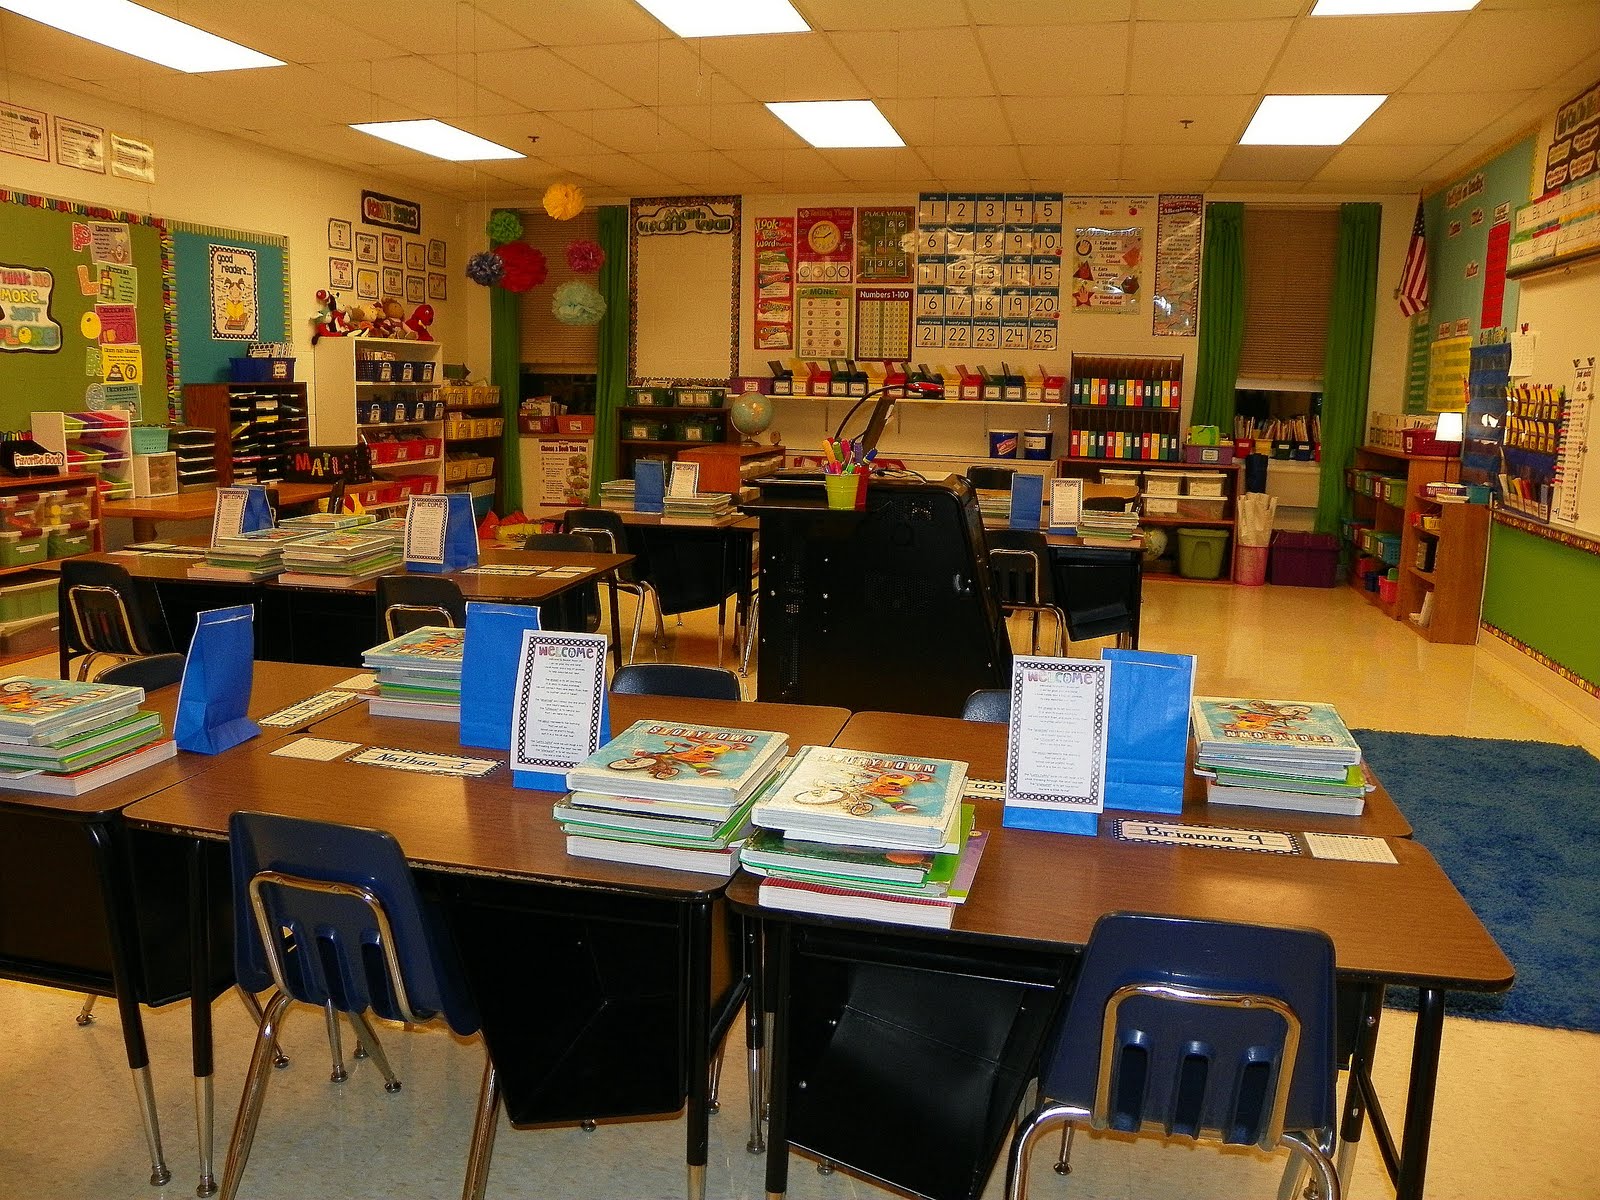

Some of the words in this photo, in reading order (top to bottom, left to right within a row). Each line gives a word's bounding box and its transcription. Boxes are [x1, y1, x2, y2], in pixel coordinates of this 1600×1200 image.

[957, 203, 966, 217] 2
[986, 203, 995, 217] 3
[1014, 204, 1024, 217] 4
[1043, 203, 1053, 217] 5
[928, 234, 937, 248] 6
[956, 234, 964, 248] 7
[984, 234, 994, 248] 8
[1014, 234, 1023, 248] 9
[1039, 234, 1055, 248] 10
[217, 254, 233, 264] good
[0, 271, 31, 286] HINK
[925, 265, 938, 279] 11
[952, 266, 966, 279] 12
[980, 266, 995, 279] 13
[1010, 266, 1025, 279] 14
[1038, 266, 1053, 280] 15
[923, 296, 937, 310] 16
[951, 296, 966, 310] 17
[979, 297, 993, 310] 18
[1009, 297, 1022, 311] 19
[1035, 298, 1054, 312] 20
[923, 327, 936, 341] 21
[949, 328, 966, 341] 22
[977, 328, 995, 342] 23
[1005, 329, 1024, 342] 24
[1034, 329, 1052, 343] 25
[15, 455, 44, 466] Favorite
[45, 454, 62, 465] Book
[296, 452, 343, 477] MAIL
[649, 725, 758, 743] STORYTOWN
[1224, 729, 1334, 744] STORYTOWN
[376, 752, 438, 767] Nathan
[819, 752, 938, 773] STORYTOWN
[1144, 826, 1234, 844] Brianna
